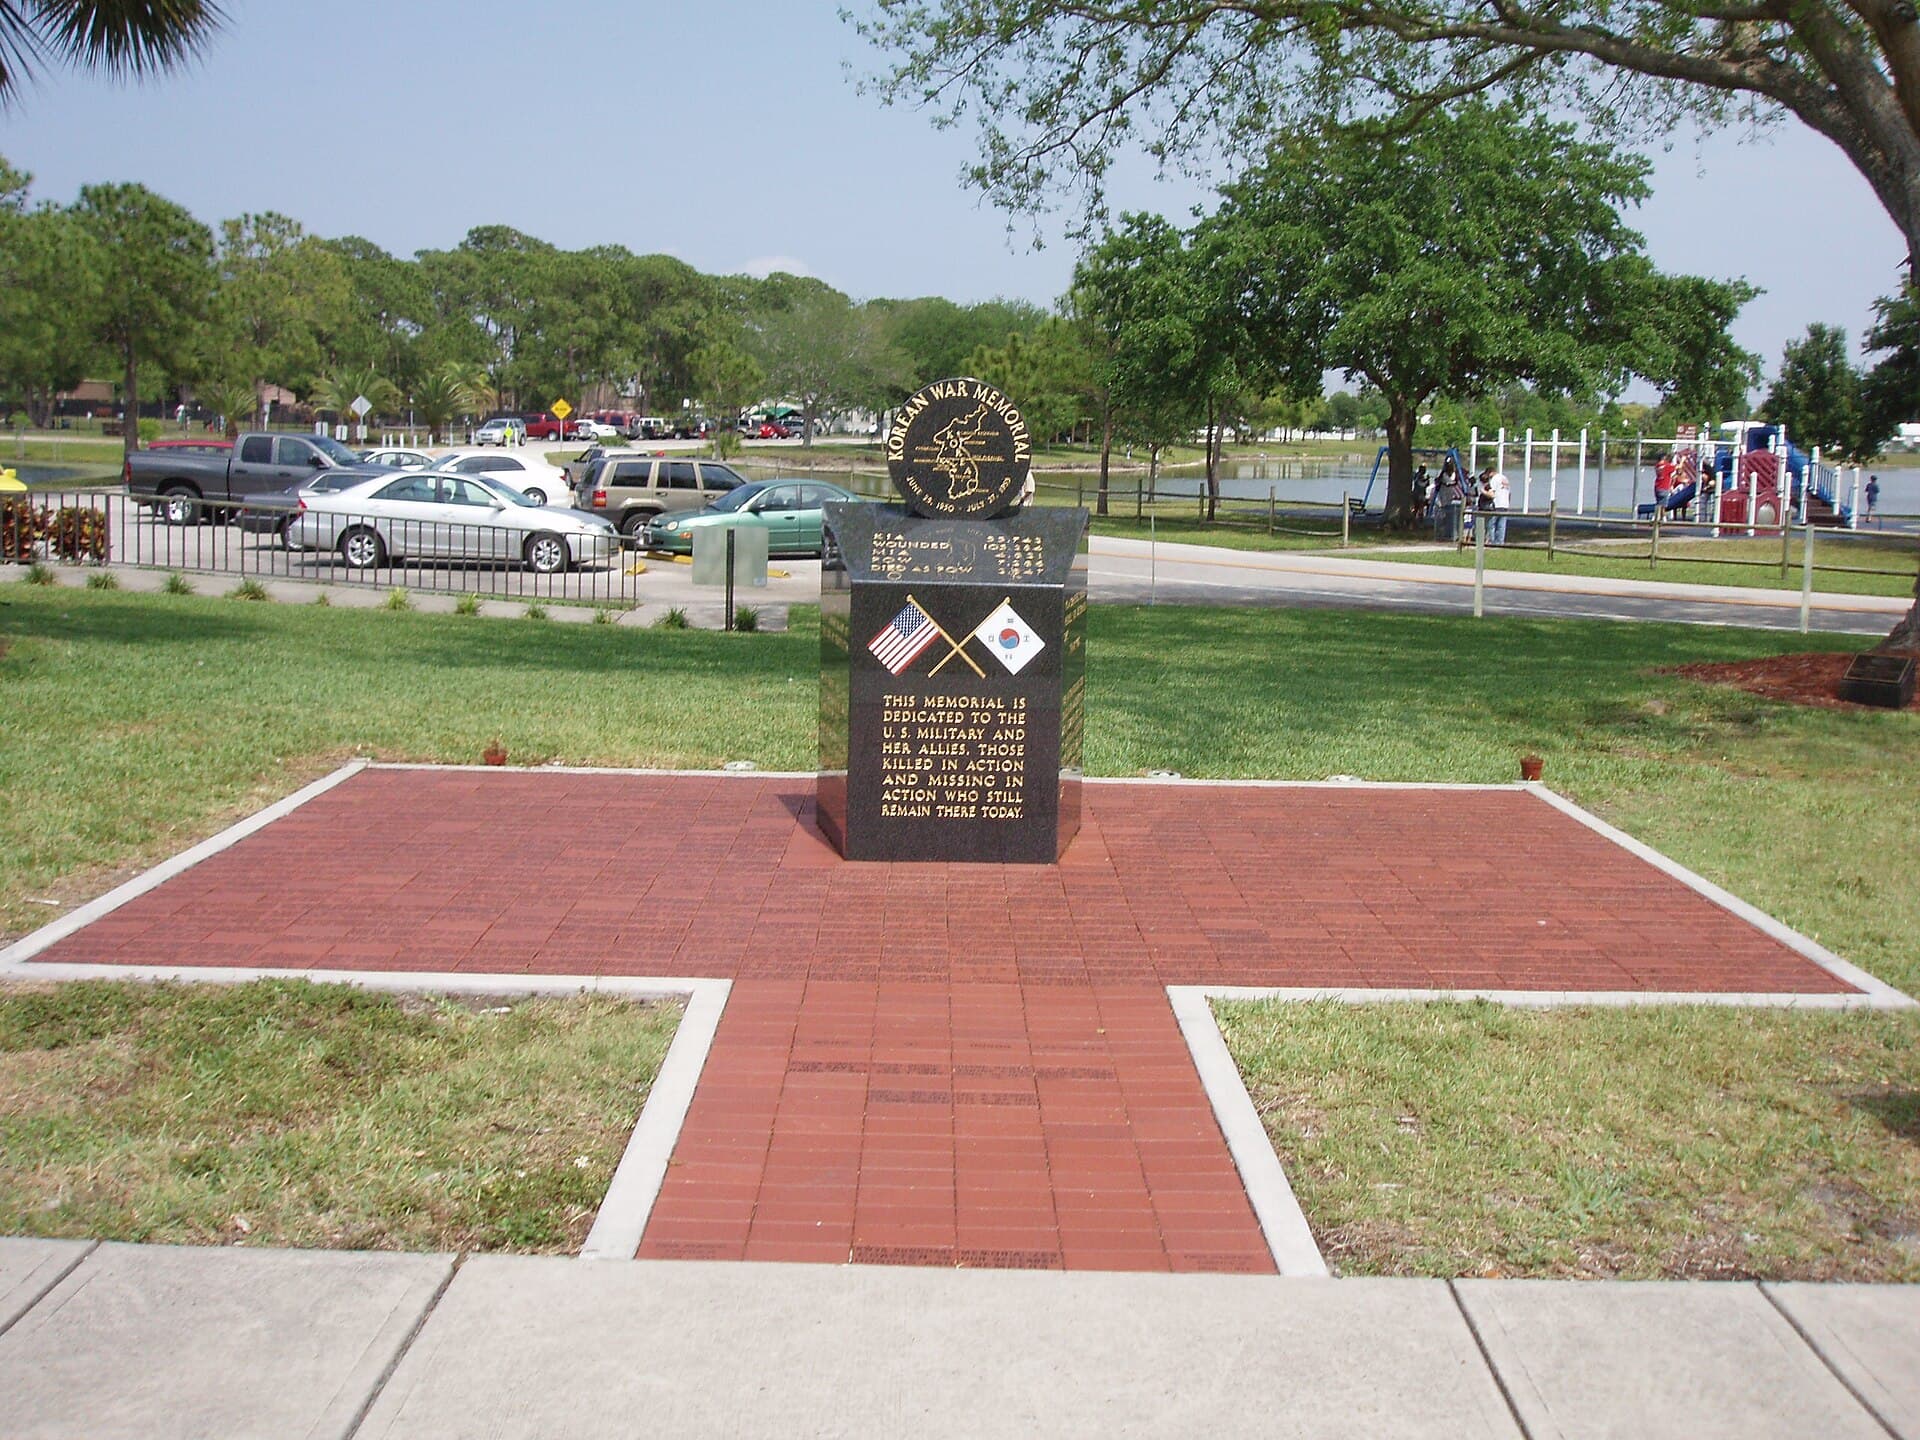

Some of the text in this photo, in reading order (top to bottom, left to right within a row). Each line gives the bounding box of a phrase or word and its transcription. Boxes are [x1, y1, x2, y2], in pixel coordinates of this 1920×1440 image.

[888, 382, 1030, 462] KOREAN WAR MEMORIAL
[906, 476, 923, 496] JUNE
[936, 502, 954, 512] 1950
[873, 541, 951, 549] WOUNDED
[883, 695, 1026, 709] THIS MEMORIAL IS
[883, 711, 1026, 724] DEDICATED TO THE
[917, 728, 985, 740] MILITARY
[993, 729, 1025, 740] AND
[882, 743, 911, 754] HER
[978, 744, 1025, 756] THOSE
[882, 758, 1024, 772] KILLED IN ACTION
[882, 774, 1024, 787] AND MISSING IN
[882, 789, 1023, 803] ACTION WHO STILL
[881, 805, 930, 817] REMAIN
[936, 805, 976, 818] THERE
